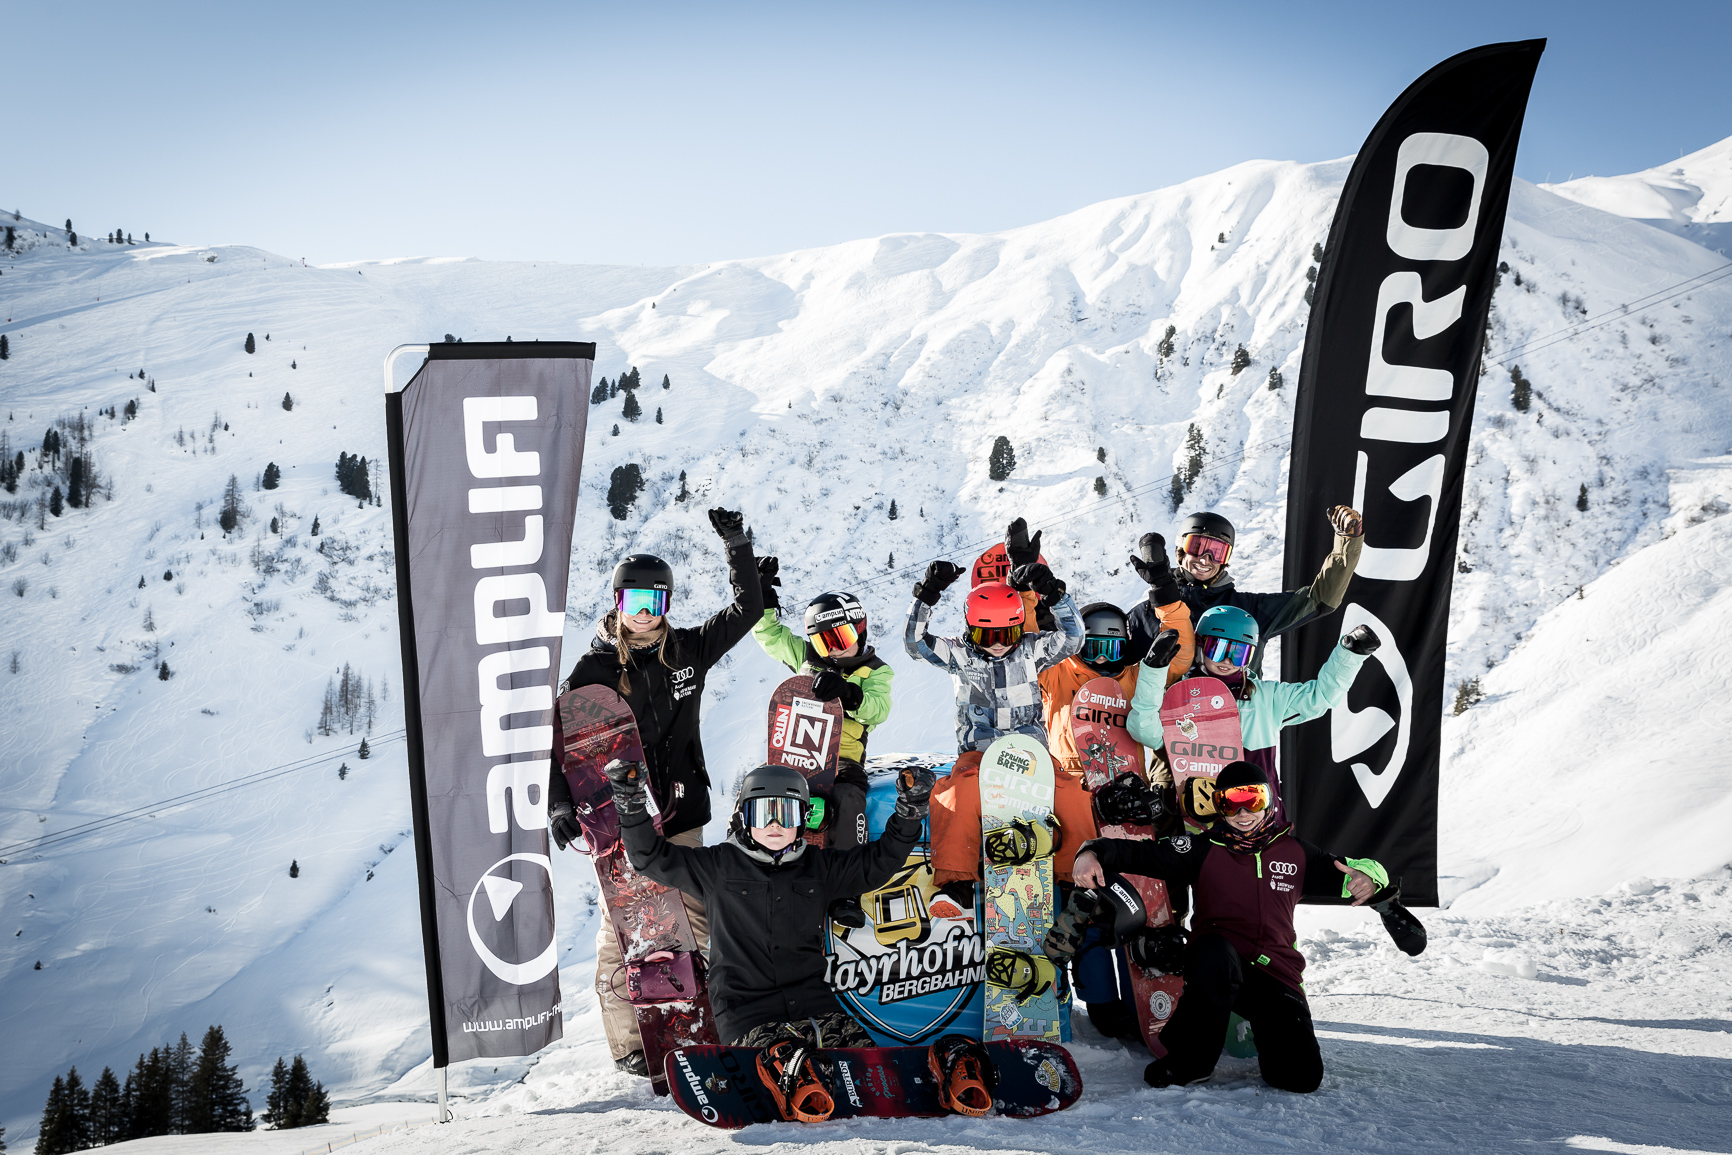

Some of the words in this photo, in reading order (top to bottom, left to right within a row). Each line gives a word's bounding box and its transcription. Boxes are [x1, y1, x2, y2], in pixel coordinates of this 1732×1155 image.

[1354, 132, 1489, 581] GIRO
[568, 693, 636, 735] GIRO
[772, 708, 789, 748] NITRO
[1076, 706, 1127, 728] GIRO
[781, 753, 818, 770] NITRO
[996, 756, 1029, 774] BRETT
[1000, 750, 1030, 766] SPRUNG
[1170, 741, 1238, 760] GIRO
[983, 767, 1052, 801] GIRO
[719, 1051, 768, 1122] GIRO
[839, 1061, 857, 1098] BURTON
